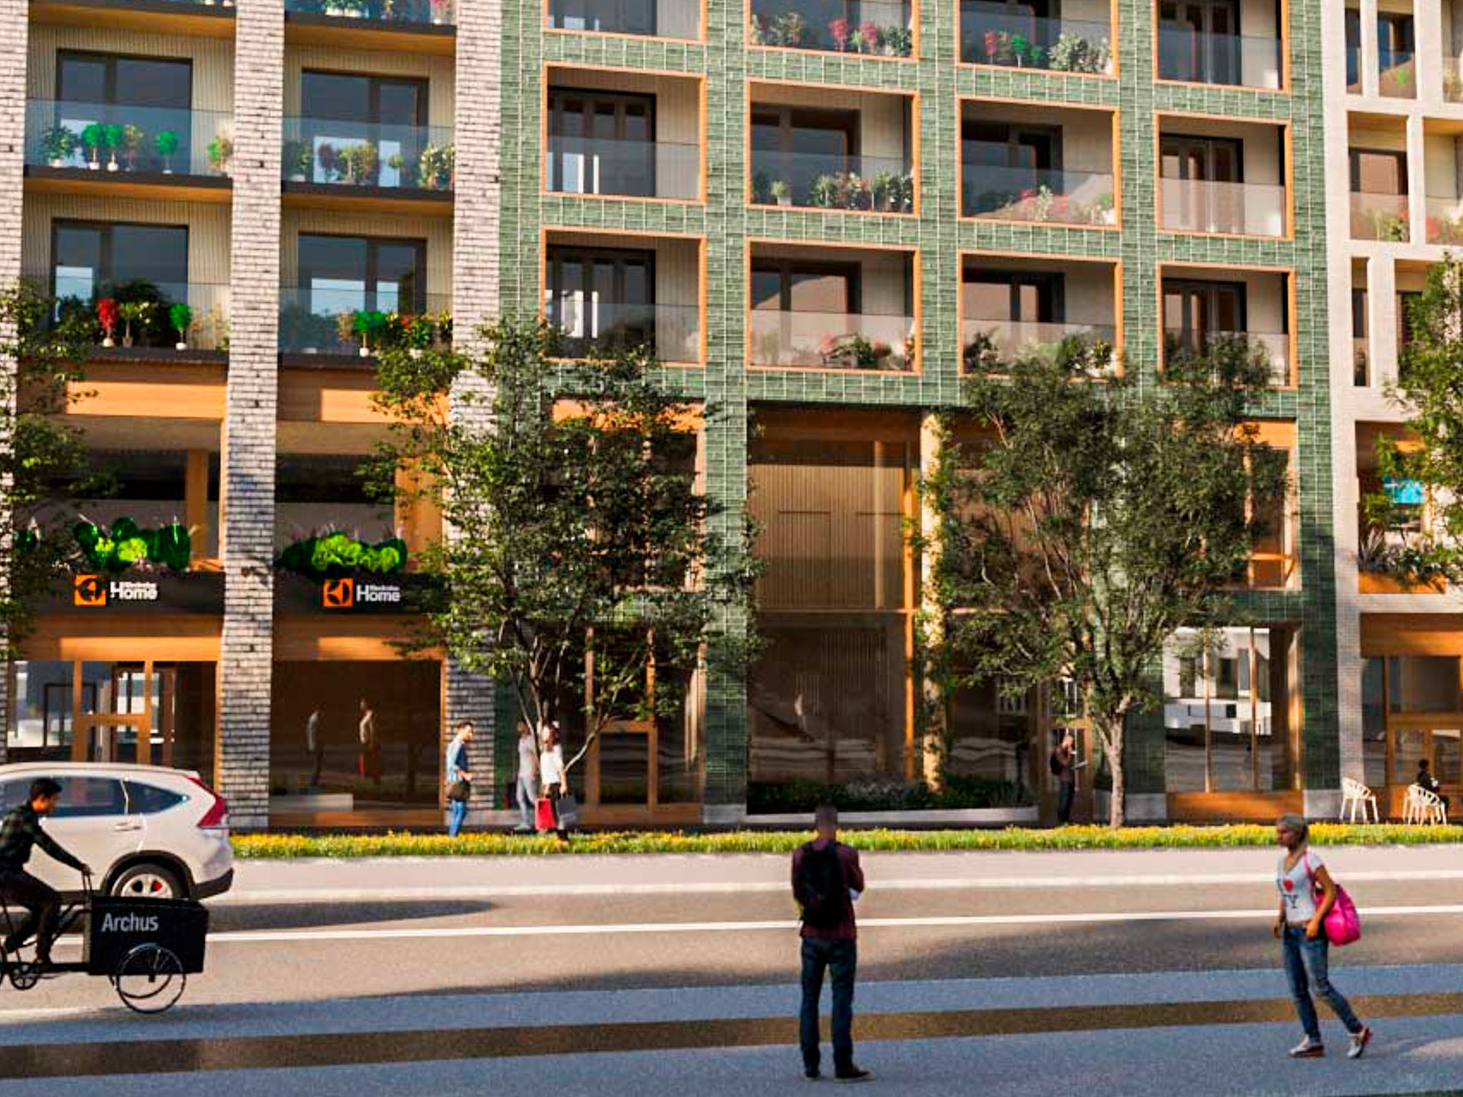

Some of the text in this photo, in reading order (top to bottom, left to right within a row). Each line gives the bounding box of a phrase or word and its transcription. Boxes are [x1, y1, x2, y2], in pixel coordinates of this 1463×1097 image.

[110, 581, 158, 600] Home
[356, 584, 401, 602] Home
[101, 912, 159, 932] Archus
